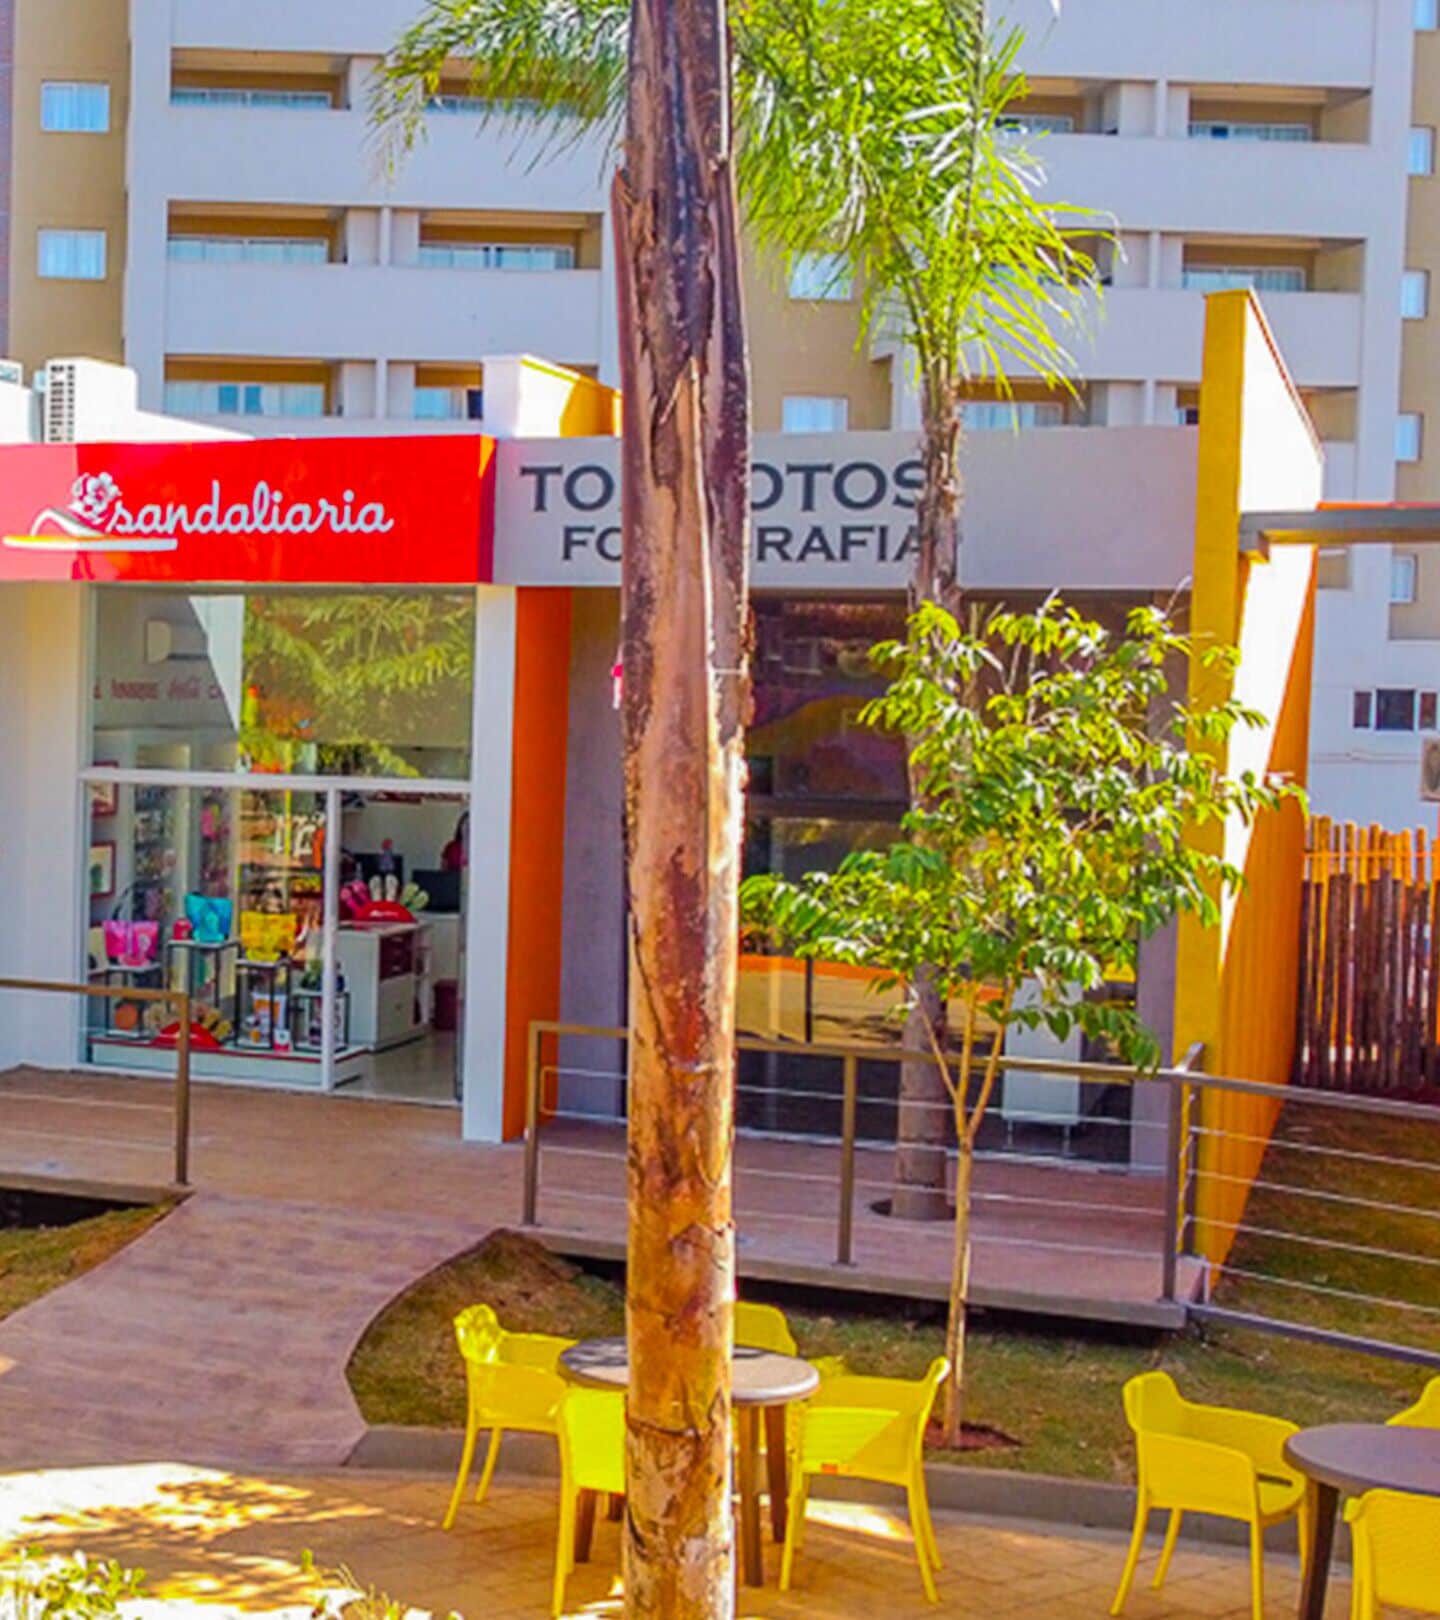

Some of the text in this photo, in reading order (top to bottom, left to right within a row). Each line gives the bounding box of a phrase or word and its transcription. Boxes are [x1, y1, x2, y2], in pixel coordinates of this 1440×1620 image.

[105, 479, 396, 534] sandaliaria
[519, 461, 926, 512] TO OTOS
[562, 525, 923, 562] FORAFIA
